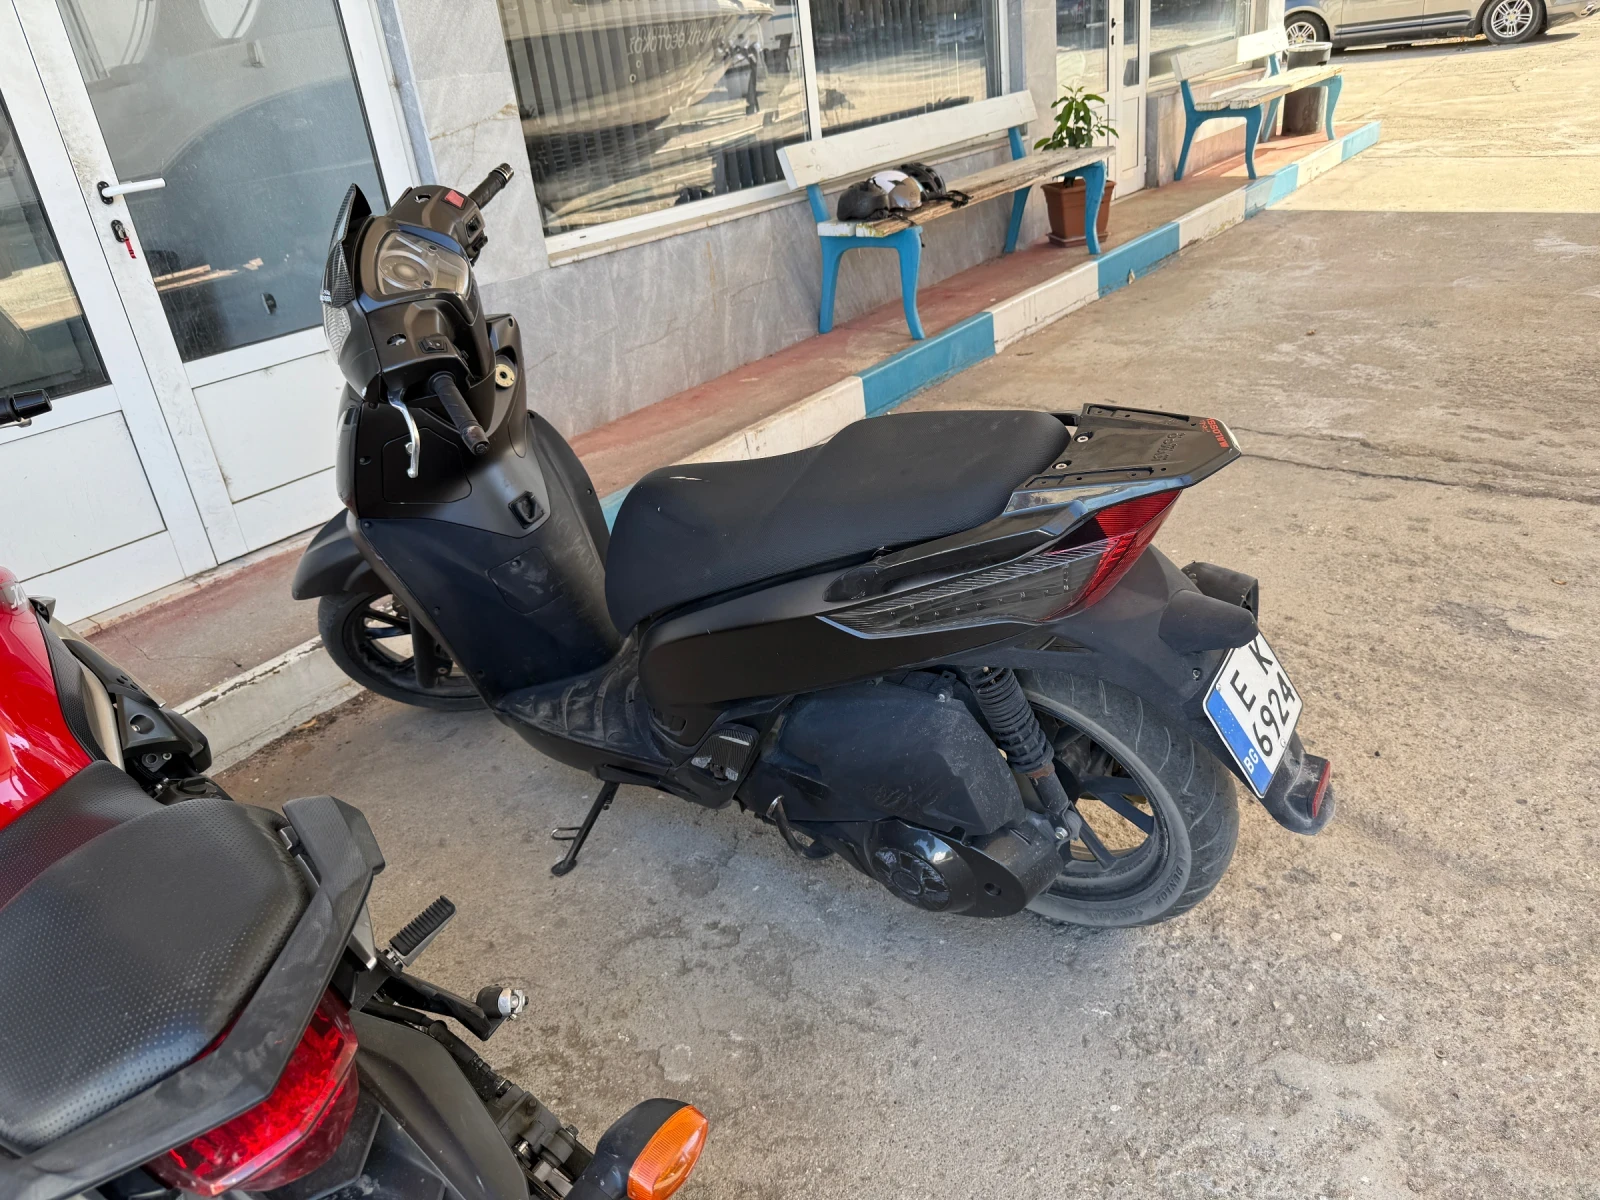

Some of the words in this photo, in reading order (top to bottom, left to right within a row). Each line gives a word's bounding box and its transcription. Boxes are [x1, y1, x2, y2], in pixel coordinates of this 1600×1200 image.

[1230, 669, 1257, 713] E
[1248, 639, 1273, 676] K
[1253, 672, 1296, 757] 6924
[1243, 748, 1260, 775] BG
[1155, 865, 1183, 905] DUNLOP
